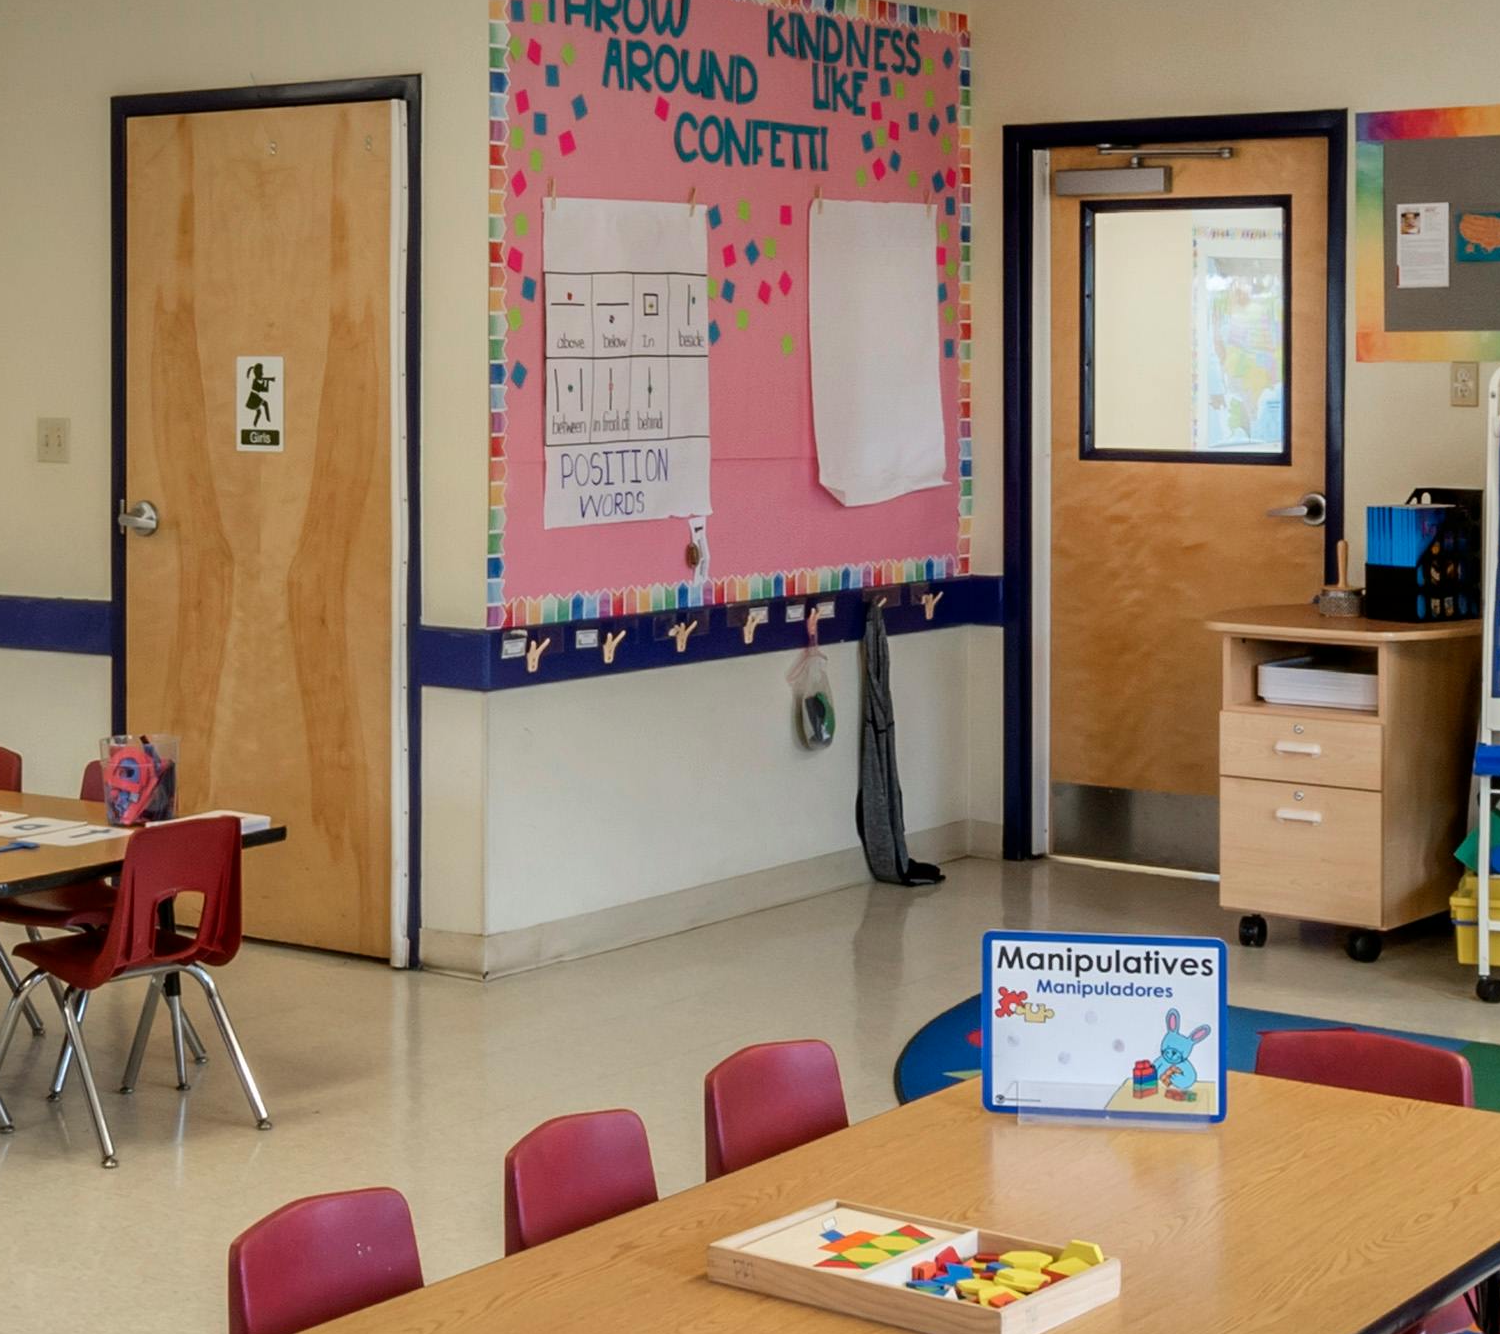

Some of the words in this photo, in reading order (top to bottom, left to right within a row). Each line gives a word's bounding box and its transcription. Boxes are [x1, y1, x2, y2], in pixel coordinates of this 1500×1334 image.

[767, 9, 922, 76] KINDNESS
[602, 38, 758, 105] AROUND
[812, 63, 868, 116] LIKE
[673, 111, 829, 171] CONFETTI
[557, 333, 585, 350] above
[602, 334, 628, 349] below
[249, 431, 272, 444] Girls
[552, 418, 587, 435] between
[561, 448, 669, 489] POSITION
[579, 491, 646, 518] WORDS
[997, 945, 1214, 978] Manipulatives
[1036, 979, 1174, 999] Manipuladores
